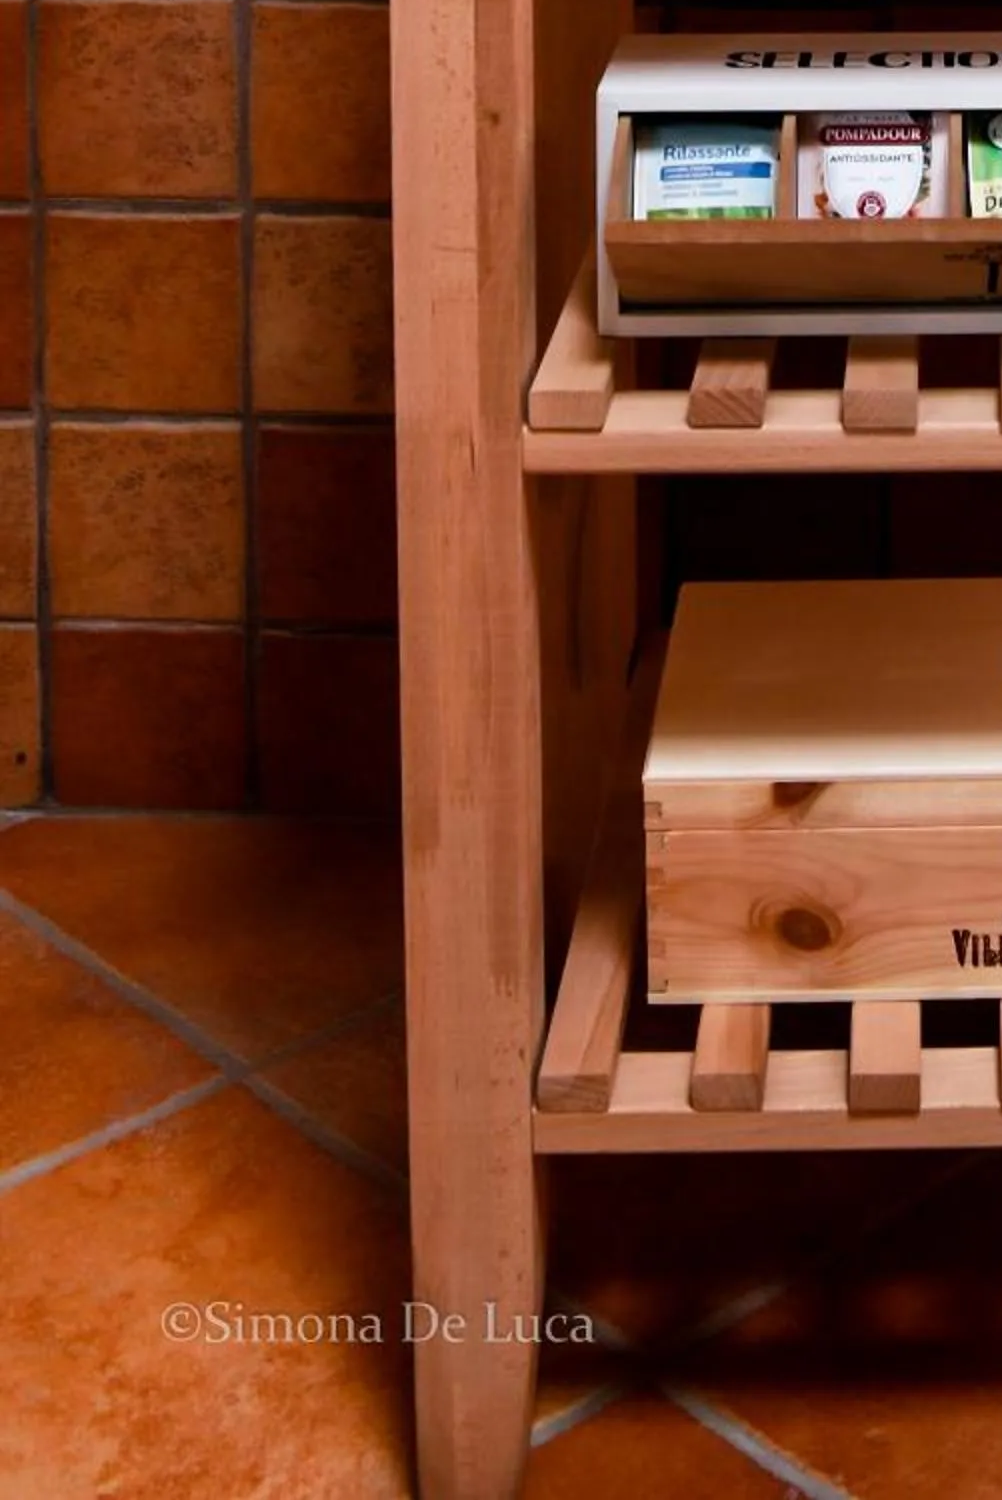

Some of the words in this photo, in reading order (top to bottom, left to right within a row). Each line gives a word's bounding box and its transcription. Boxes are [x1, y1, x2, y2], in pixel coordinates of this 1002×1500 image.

[825, 126, 922, 141] POMPADOUR
[663, 143, 751, 161] Rilassante
[829, 153, 913, 163] ANTIOSSIDANTE
